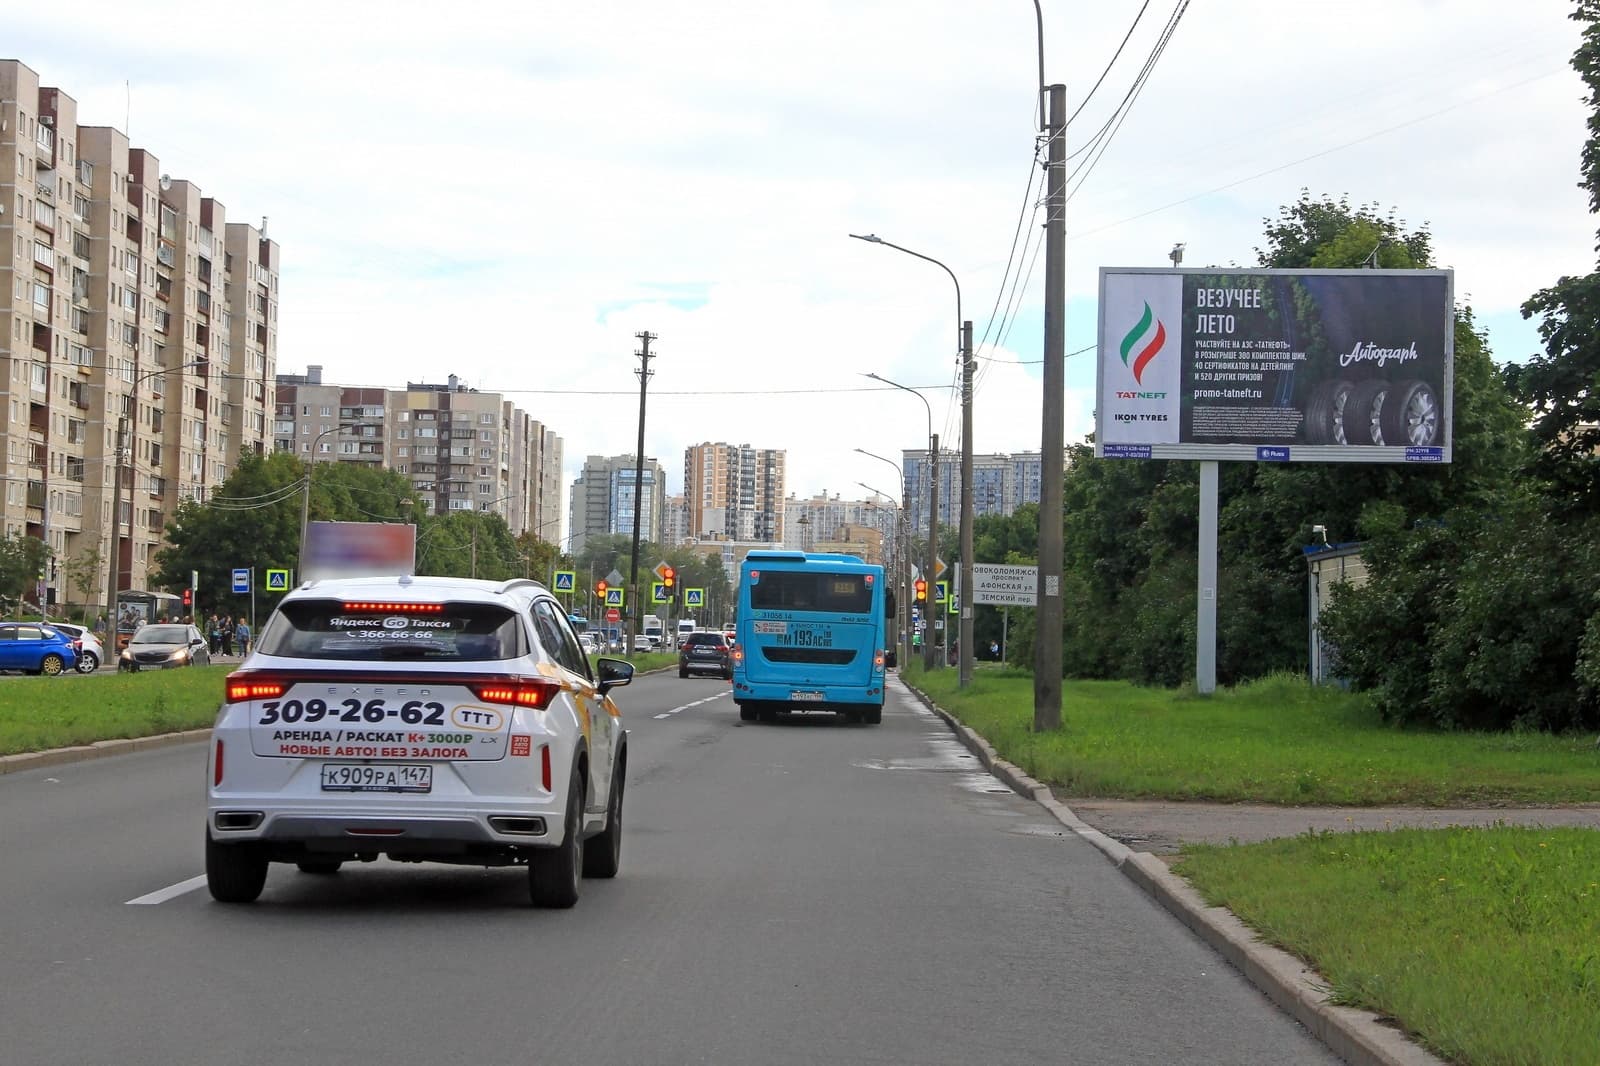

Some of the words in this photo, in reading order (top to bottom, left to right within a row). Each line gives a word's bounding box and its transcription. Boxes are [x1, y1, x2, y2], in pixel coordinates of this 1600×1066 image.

[1197, 288, 1261, 308] ВЕЗУЧЕЕ
[1195, 314, 1235, 334] ЛЕТО
[1195, 339, 1231, 348] УЧАСТВУЙТЕ
[1195, 351, 1200, 359] В
[1200, 351, 1237, 359] РОЗЫГРЫШЕ
[1251, 352, 1290, 360] КОМПЛЕКТОВ
[1291, 352, 1307, 360] ШИН,
[1340, 341, 1418, 368] Autograph
[1195, 361, 1203, 369] 40
[1204, 362, 1250, 370] СЕРТИФИКАТОВ
[1250, 362, 1259, 370] НА
[1260, 361, 1295, 371] ДЕТЕЙЛИНГ
[1194, 372, 1200, 380] И
[1213, 373, 1236, 381] ДРУГИХ
[1237, 373, 1263, 381] ПРИЗОВ!
[1116, 391, 1167, 399] TATNEFT
[1194, 388, 1262, 399] promo-tatneft.ru
[981, 582, 1022, 590] АФОНСКАЯ
[330, 617, 380, 627] Яндекс
[411, 619, 451, 628] Такси
[359, 630, 433, 639] 366-66-66
[259, 698, 445, 725] 309-26-62
[461, 711, 494, 725] ТТТ
[273, 730, 332, 742] АРЕНДА
[336, 730, 343, 742] /
[346, 731, 404, 742] РАСКАТ
[408, 733, 425, 742] К+
[280, 744, 331, 755] НОВЫЕ
[335, 746, 377, 756] АВТО!
[381, 747, 407, 757] БЕЗ
[411, 747, 468, 758] ЗАЛОГА
[328, 767, 397, 785] К909РА
[401, 767, 427, 781] 147
